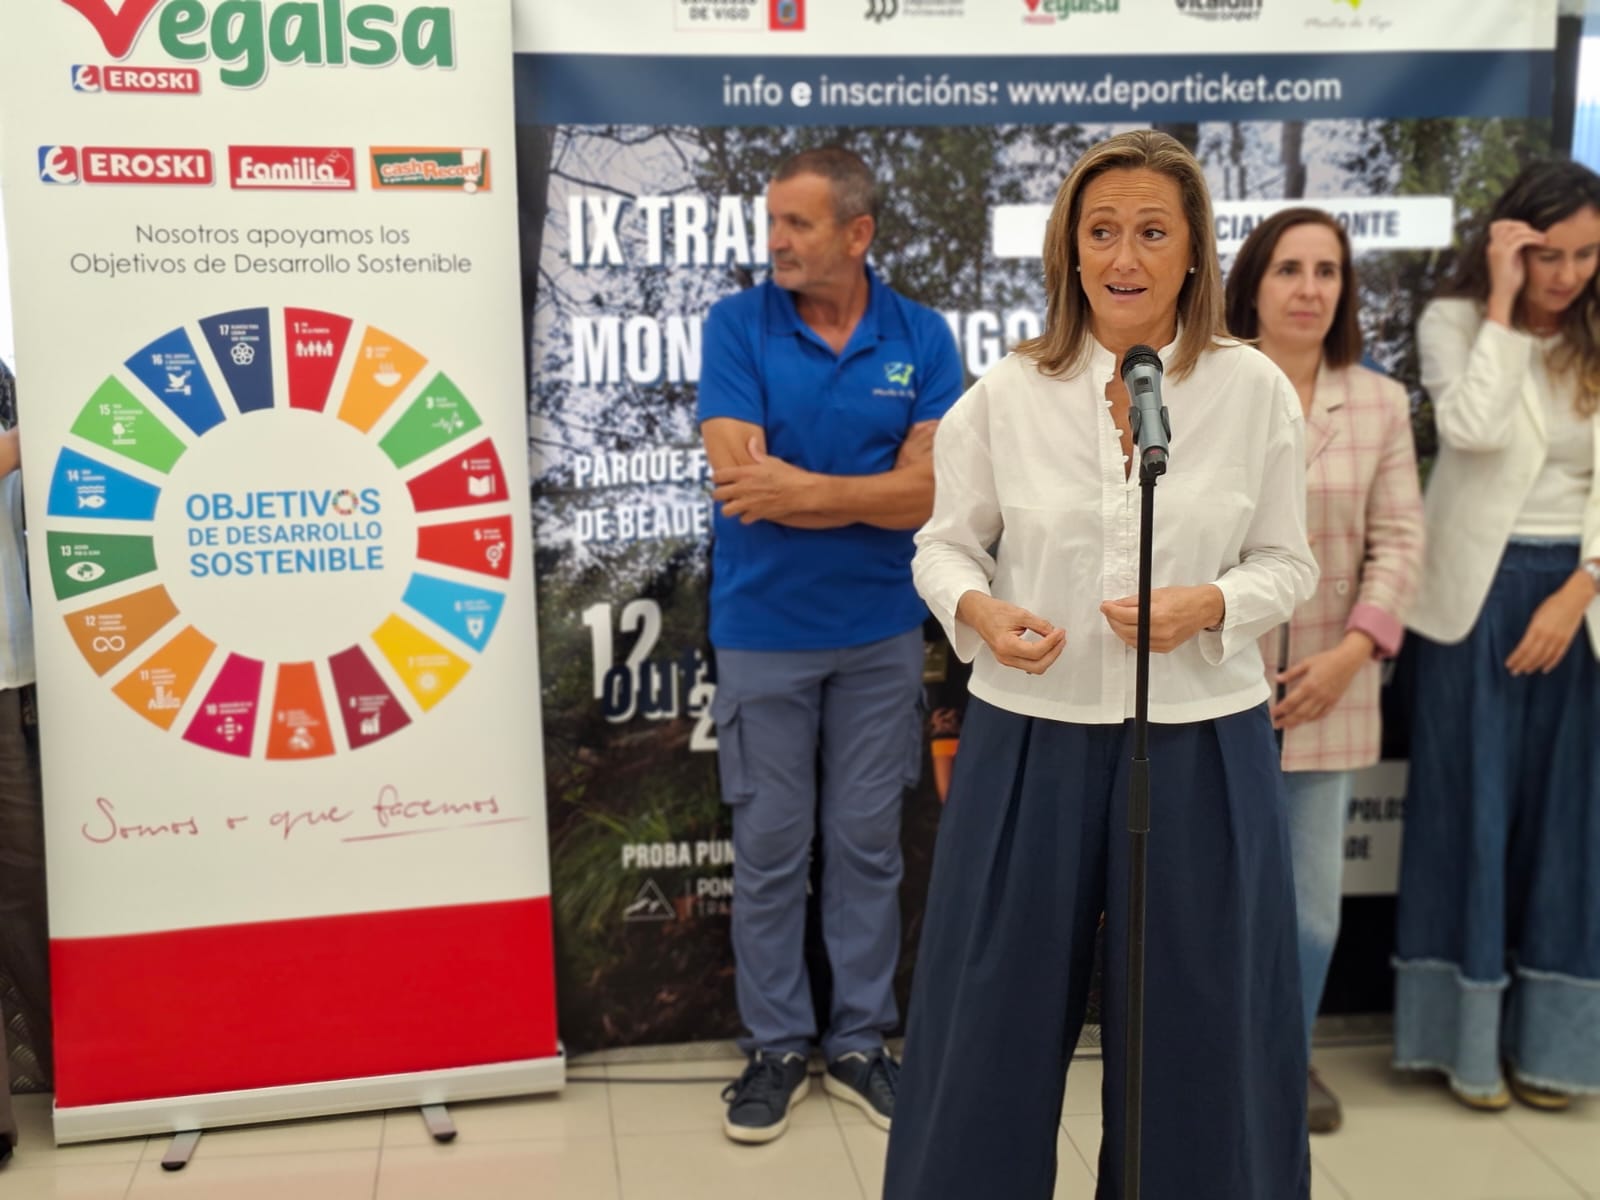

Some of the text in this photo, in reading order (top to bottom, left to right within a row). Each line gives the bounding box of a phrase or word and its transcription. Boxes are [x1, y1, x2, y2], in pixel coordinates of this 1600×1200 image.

[689, 7, 750, 20] DE VIGO
[110, 71, 194, 89] EROSKI
[723, 74, 1342, 109] info e inscricións: www.deporticket.com
[90, 154, 206, 179] EROSKI
[136, 225, 410, 250] Nosotros apoyamos los
[569, 195, 768, 265] IX TRAI
[70, 253, 473, 279] Objetivos de Desarrollo Sostenible
[219, 324, 230, 336] 17
[573, 316, 702, 383] MON
[100, 403, 111, 416] 15
[67, 469, 79, 482] 14
[574, 449, 685, 488] PARQUE
[186, 488, 381, 521] OBJETIVOS
[188, 522, 382, 547] DE DESARROLLO
[577, 503, 708, 541] DE BEADE
[61, 545, 72, 557] 13
[190, 547, 384, 576] SOSTENIBLE
[85, 615, 96, 627] 12
[582, 598, 661, 700] 12
[602, 649, 712, 723] out
[82, 797, 199, 843] Somos
[269, 808, 352, 839] que
[372, 784, 500, 827] facemos
[622, 840, 735, 869] PROBA PUN
[697, 878, 735, 896] PON
